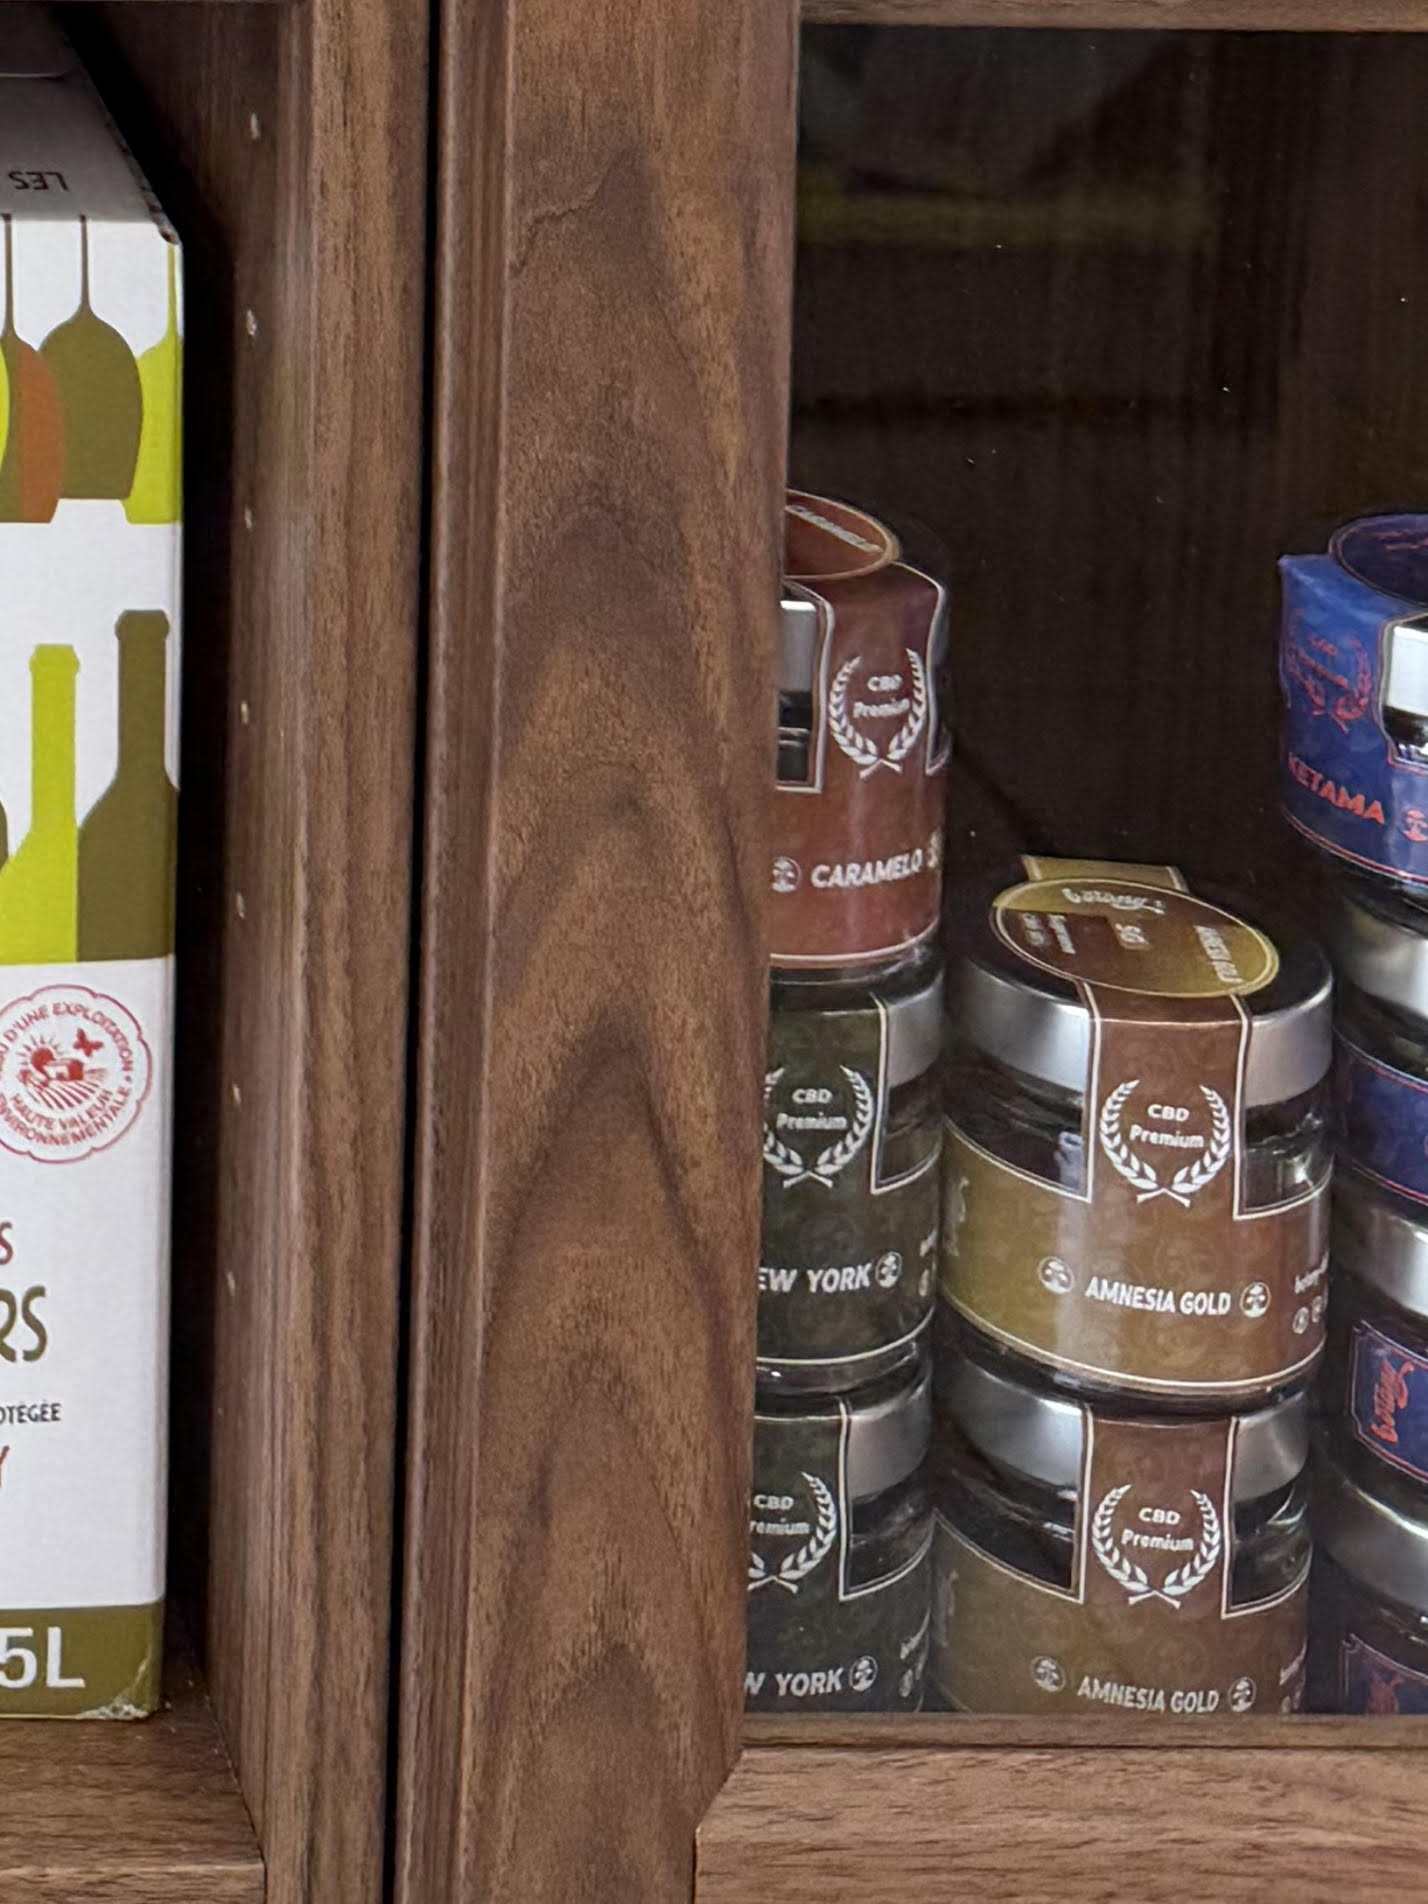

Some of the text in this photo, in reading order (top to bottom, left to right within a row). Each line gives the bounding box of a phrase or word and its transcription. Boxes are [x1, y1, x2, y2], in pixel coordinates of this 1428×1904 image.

[853, 699, 910, 718] Premium
[1288, 752, 1385, 824] KETAMA
[811, 849, 922, 888] CARAMELO
[793, 1090, 831, 1104] CBD
[777, 1112, 846, 1131] Premium
[1148, 1105, 1188, 1122] CBD
[1130, 1125, 1203, 1147] Premium
[806, 1265, 871, 1292] YORK
[1085, 1277, 1230, 1316] AMNESIA GOLD
[754, 1495, 793, 1509] CBD
[1138, 1508, 1179, 1525] CBD
[1121, 1529, 1193, 1550] Premium
[777, 1669, 842, 1695] YORK
[1078, 1679, 1218, 1713] AMNESIA GOLD
